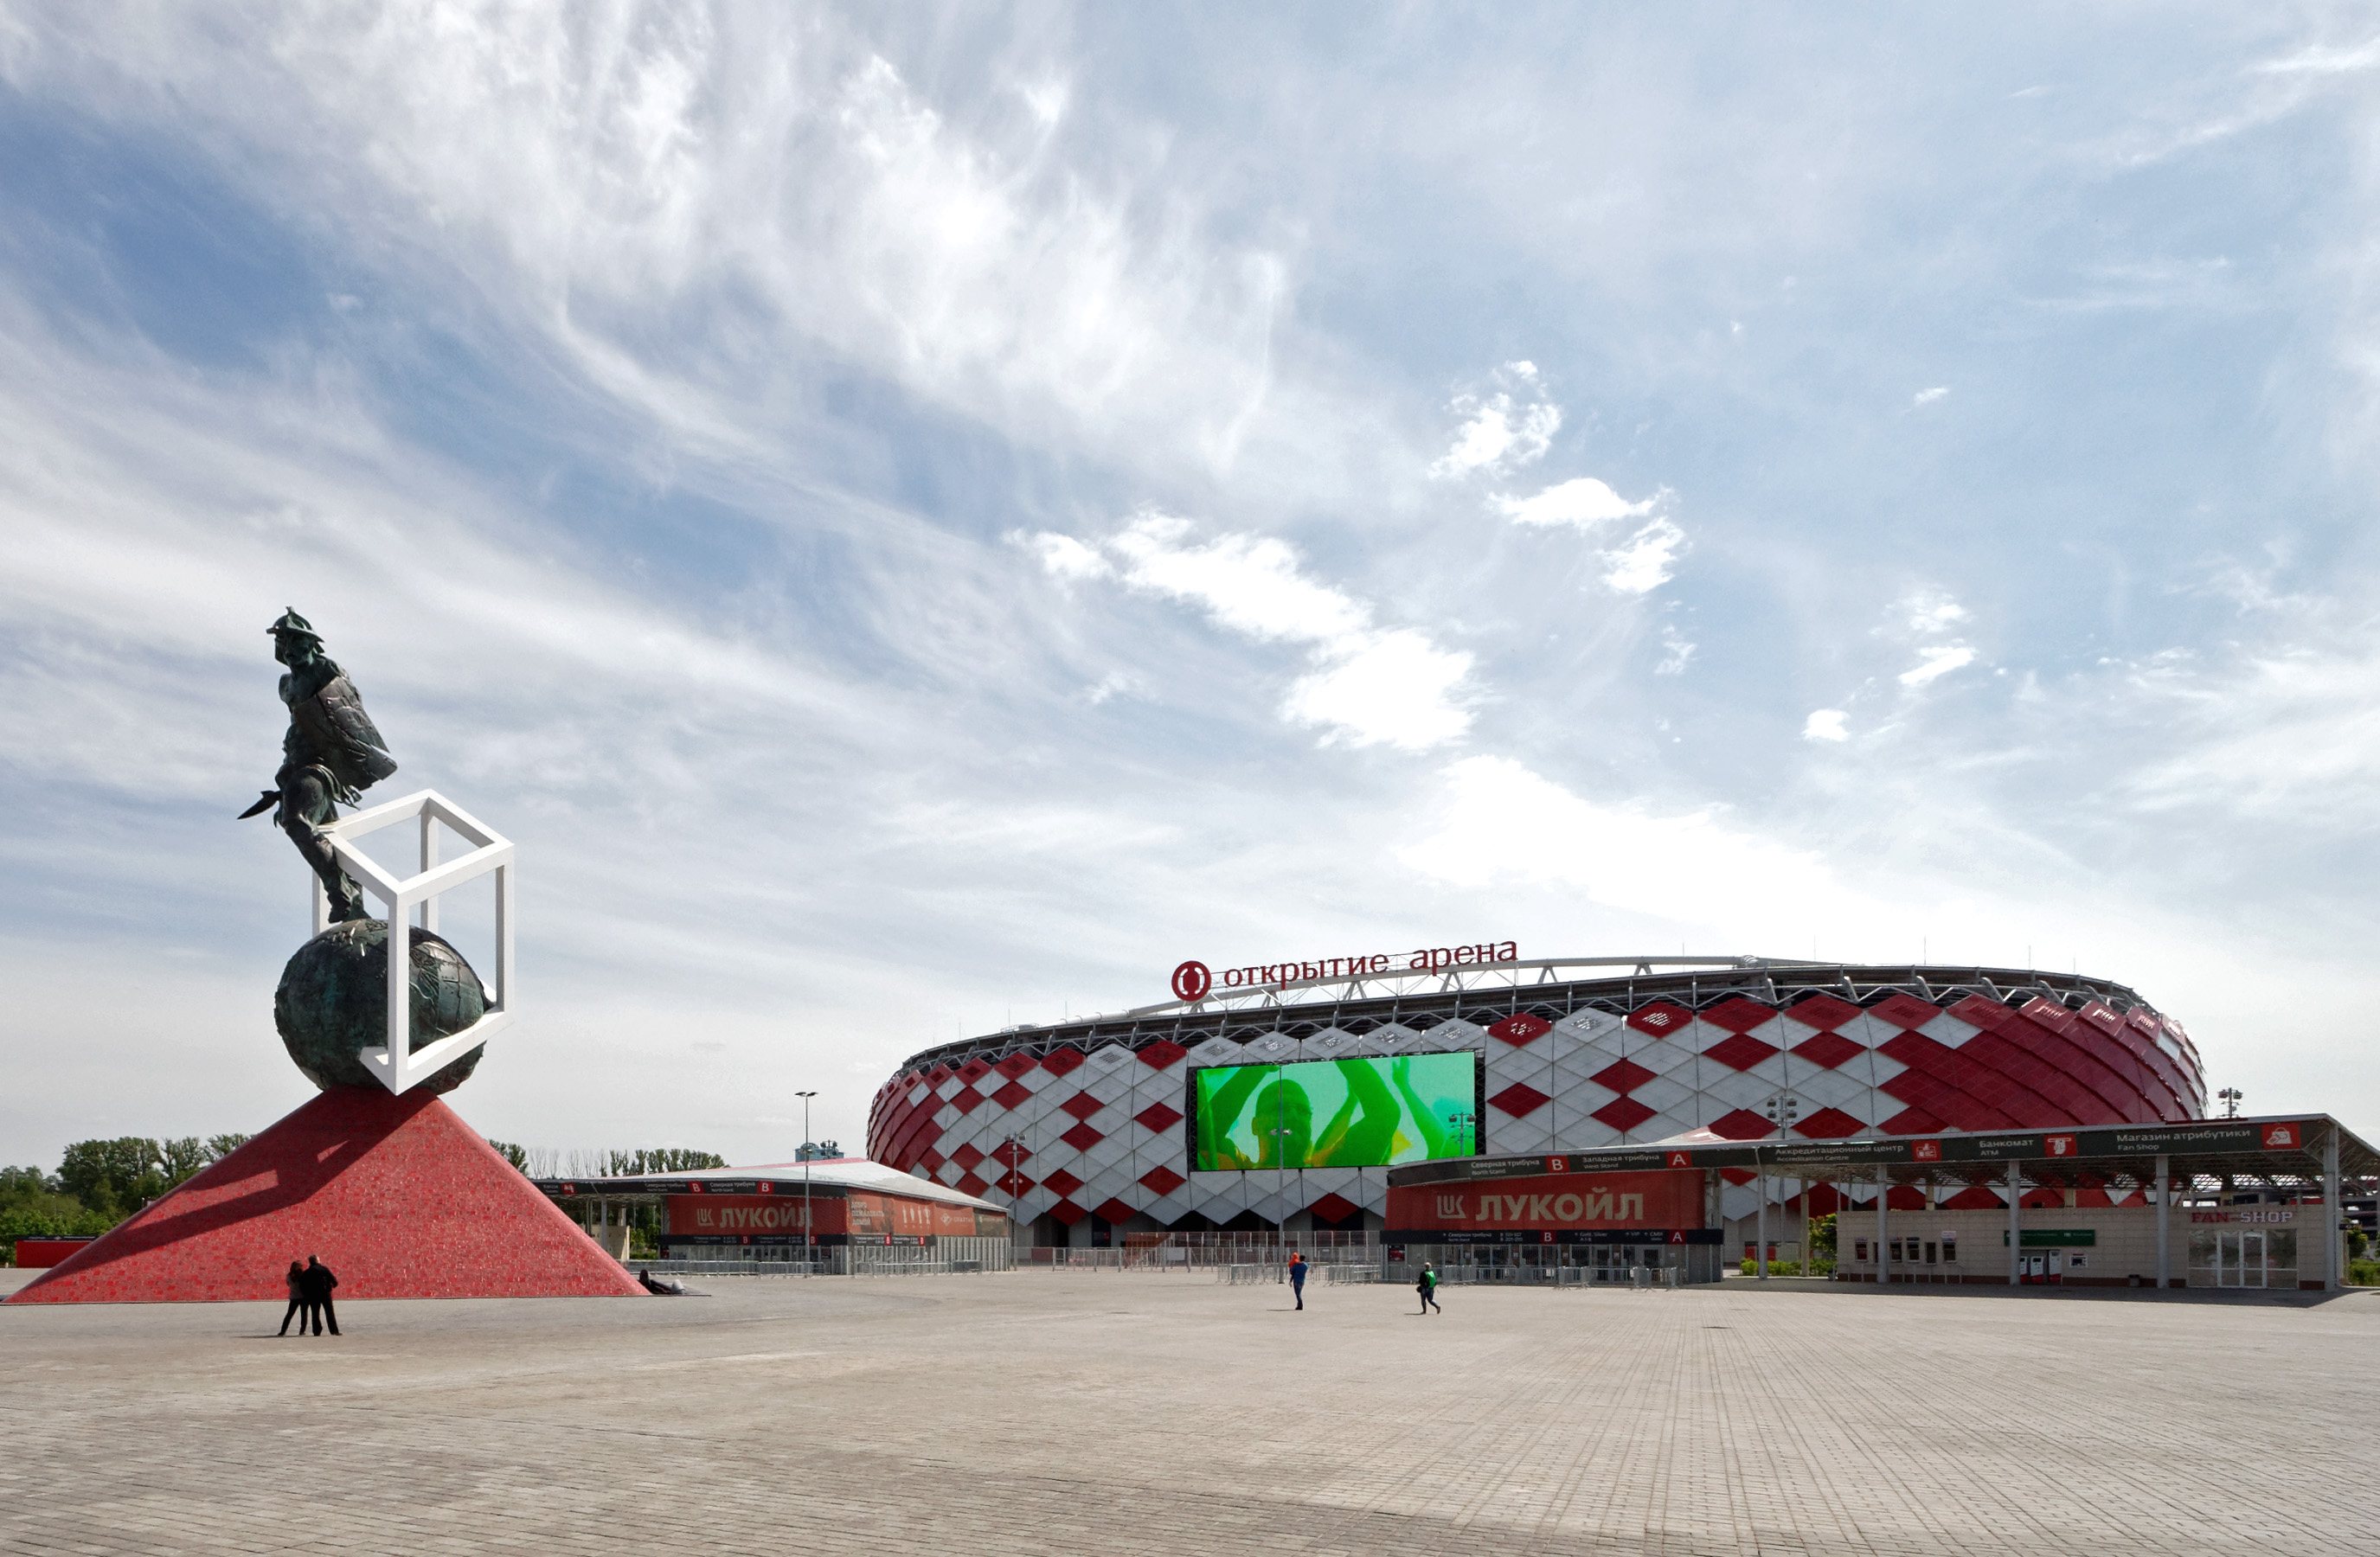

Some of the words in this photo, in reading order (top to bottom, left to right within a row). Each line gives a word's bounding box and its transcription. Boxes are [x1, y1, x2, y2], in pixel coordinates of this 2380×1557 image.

[1223, 953, 1389, 990] открытие
[1409, 940, 1518, 977] арена
[2116, 1133, 2172, 1143] Магазин
[2173, 1130, 2250, 1142] атрибутики
[1873, 1144, 1904, 1154] центр
[1979, 1139, 2035, 1148] Банкомат
[1471, 1161, 1506, 1169] Северная
[1508, 1158, 1540, 1168] трибуна
[1582, 1155, 1622, 1163] Западная
[1624, 1153, 1660, 1162] трибуна
[1475, 1186, 1644, 1222] ЛУКОЙЛ
[719, 1201, 813, 1228] ЛУКОЙЛ
[2191, 1212, 2229, 1223] FAN
[2240, 1211, 2293, 1223] SHOP
